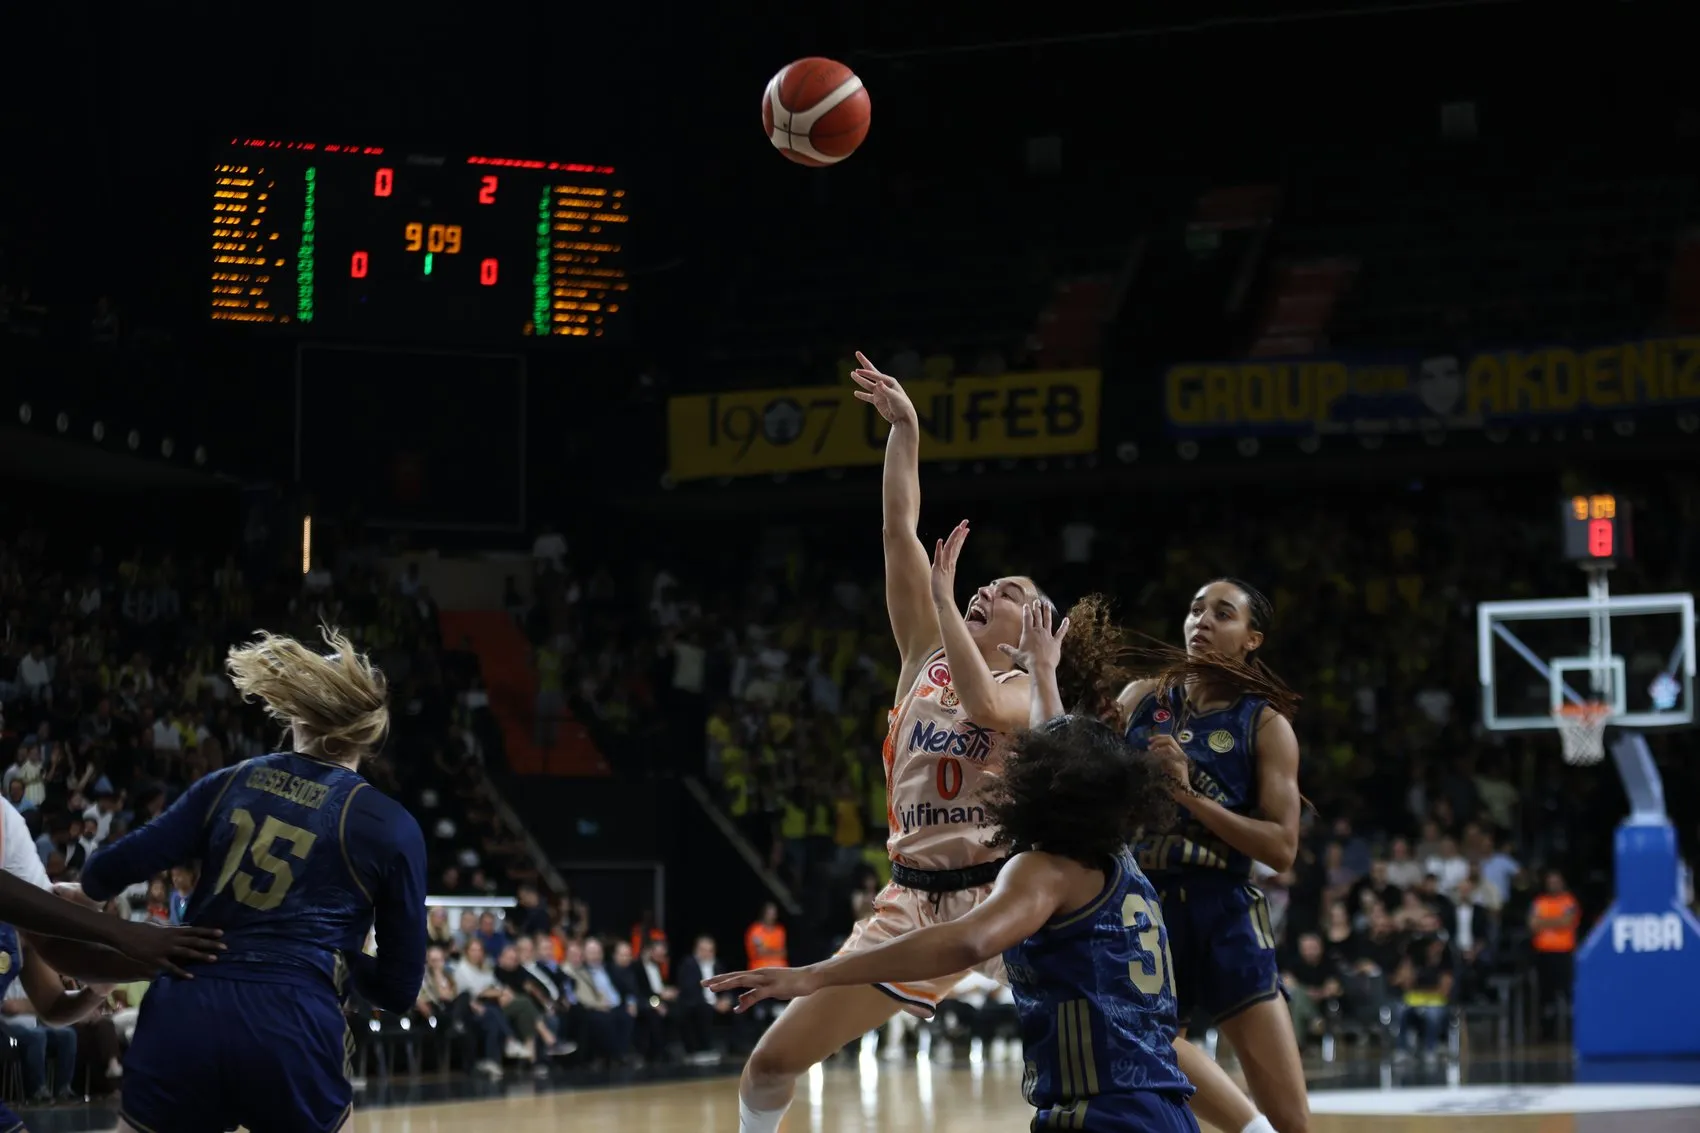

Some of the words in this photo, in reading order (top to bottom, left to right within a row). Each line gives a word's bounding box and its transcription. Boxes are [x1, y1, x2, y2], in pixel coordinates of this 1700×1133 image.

[373, 167, 394, 197] 0
[478, 175, 499, 205] 2
[350, 251, 369, 279] 0
[480, 258, 499, 286] 0
[423, 253, 433, 276] 1
[1168, 364, 1347, 421] GROUP
[936, 757, 962, 800] 0
[213, 807, 318, 912] 15
[1613, 913, 1684, 953] FIBA
